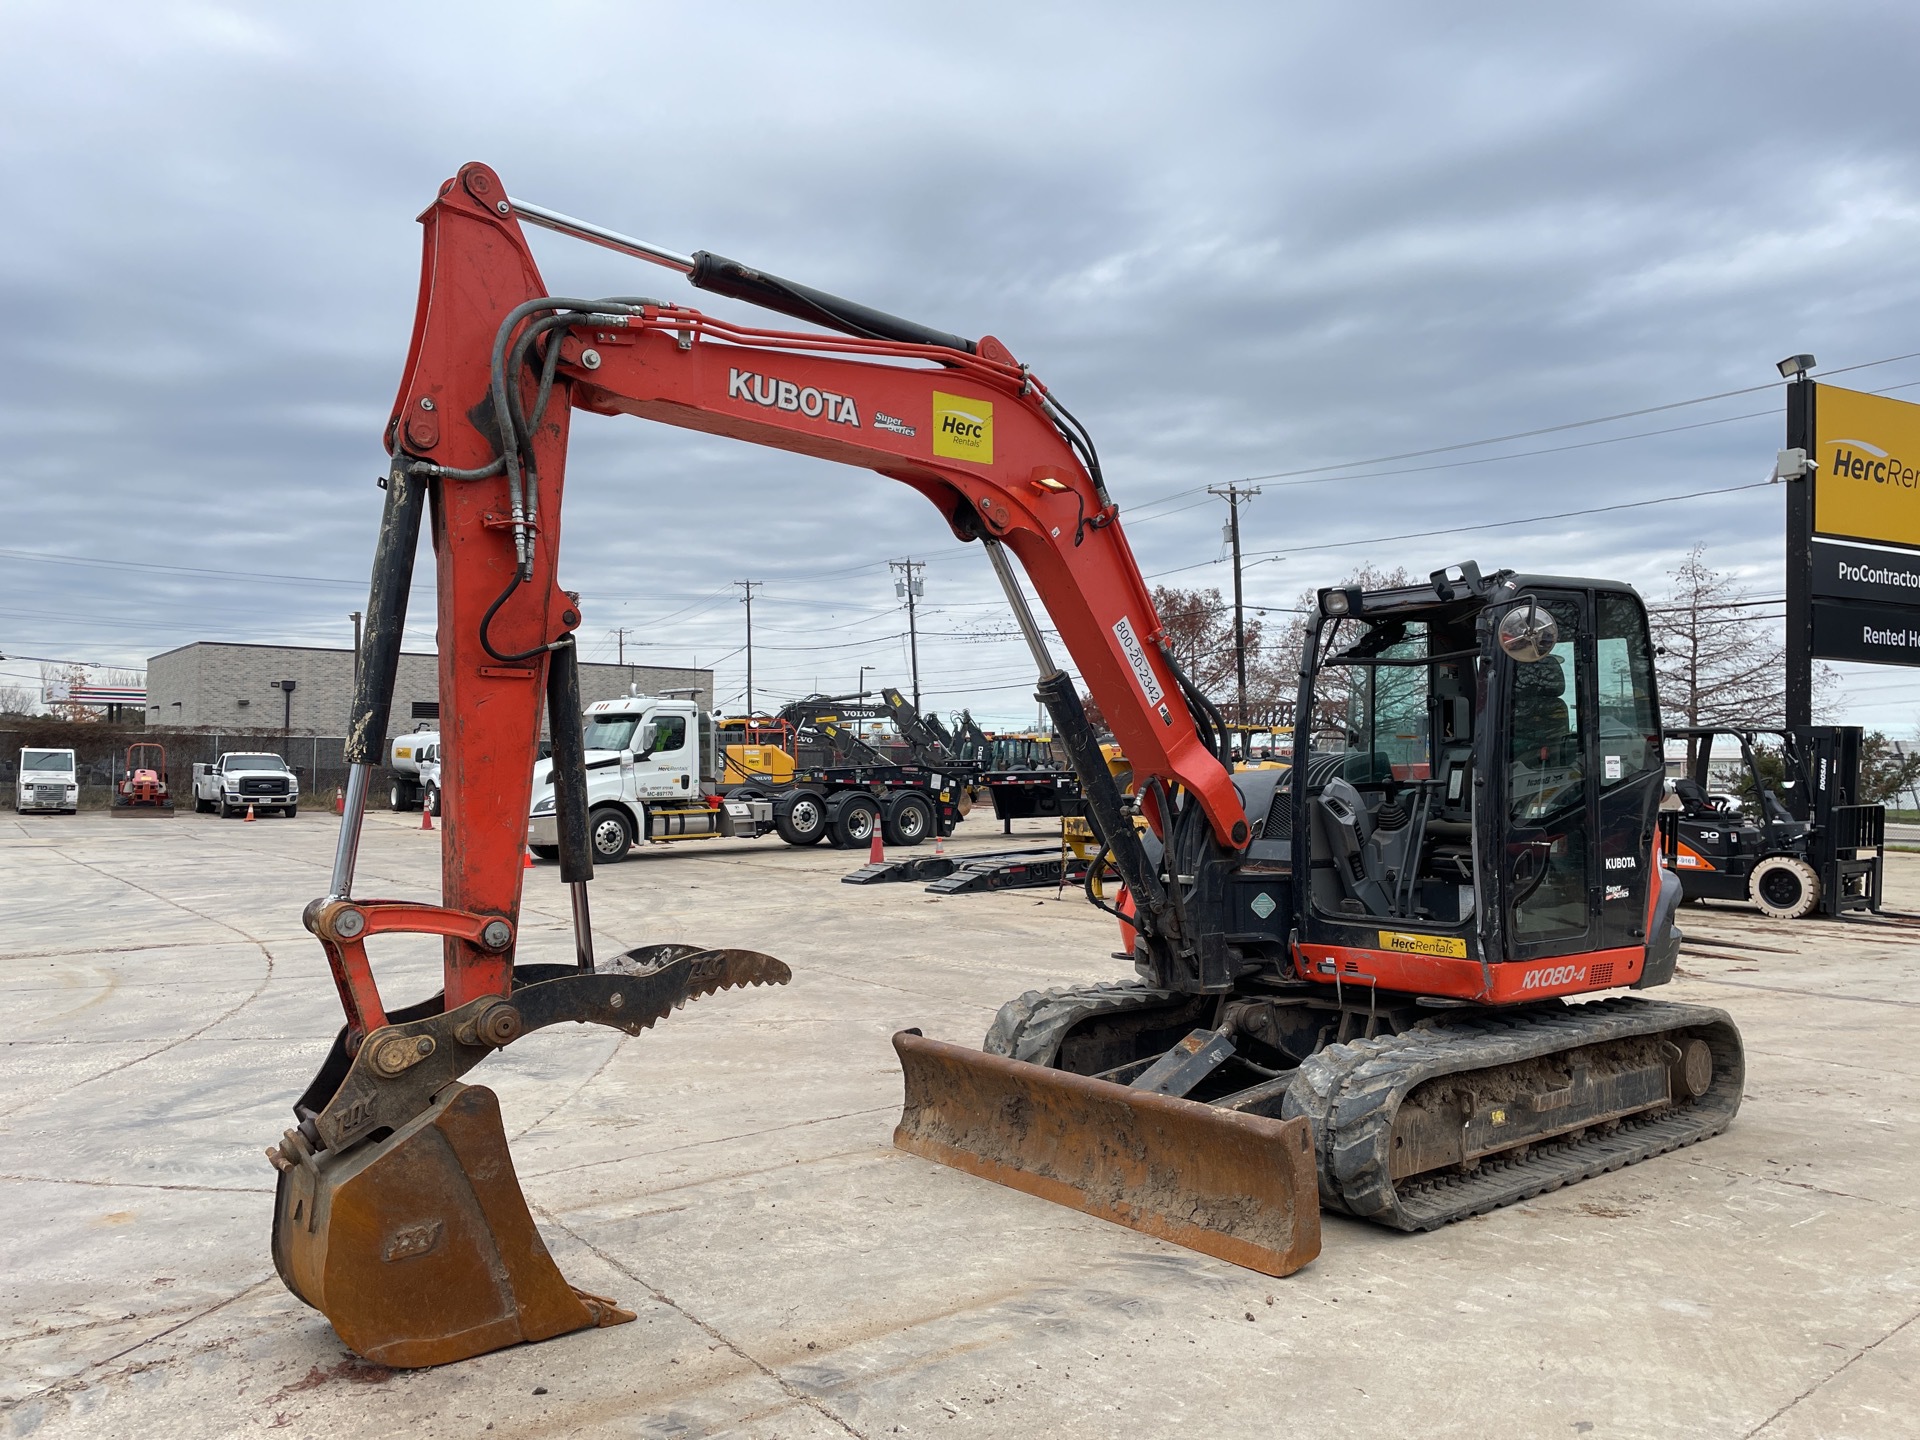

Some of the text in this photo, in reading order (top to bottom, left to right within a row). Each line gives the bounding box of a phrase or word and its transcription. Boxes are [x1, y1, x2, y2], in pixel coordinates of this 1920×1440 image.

[729, 367, 860, 427] KUBOTA
[875, 412, 903, 426] Super
[942, 415, 983, 438] Herc
[887, 424, 915, 437] Series
[952, 435, 981, 448] Rentals
[1863, 626, 1906, 647] Rented
[1116, 621, 1160, 703] 800-20-2342
[1819, 757, 1828, 791] DOOSAN
[1700, 831, 1720, 839] 30
[1605, 856, 1637, 870] KUBOTA
[1605, 885, 1622, 895] Super
[1391, 937, 1454, 955] HercRentals
[1521, 964, 1587, 989] KX080-4
